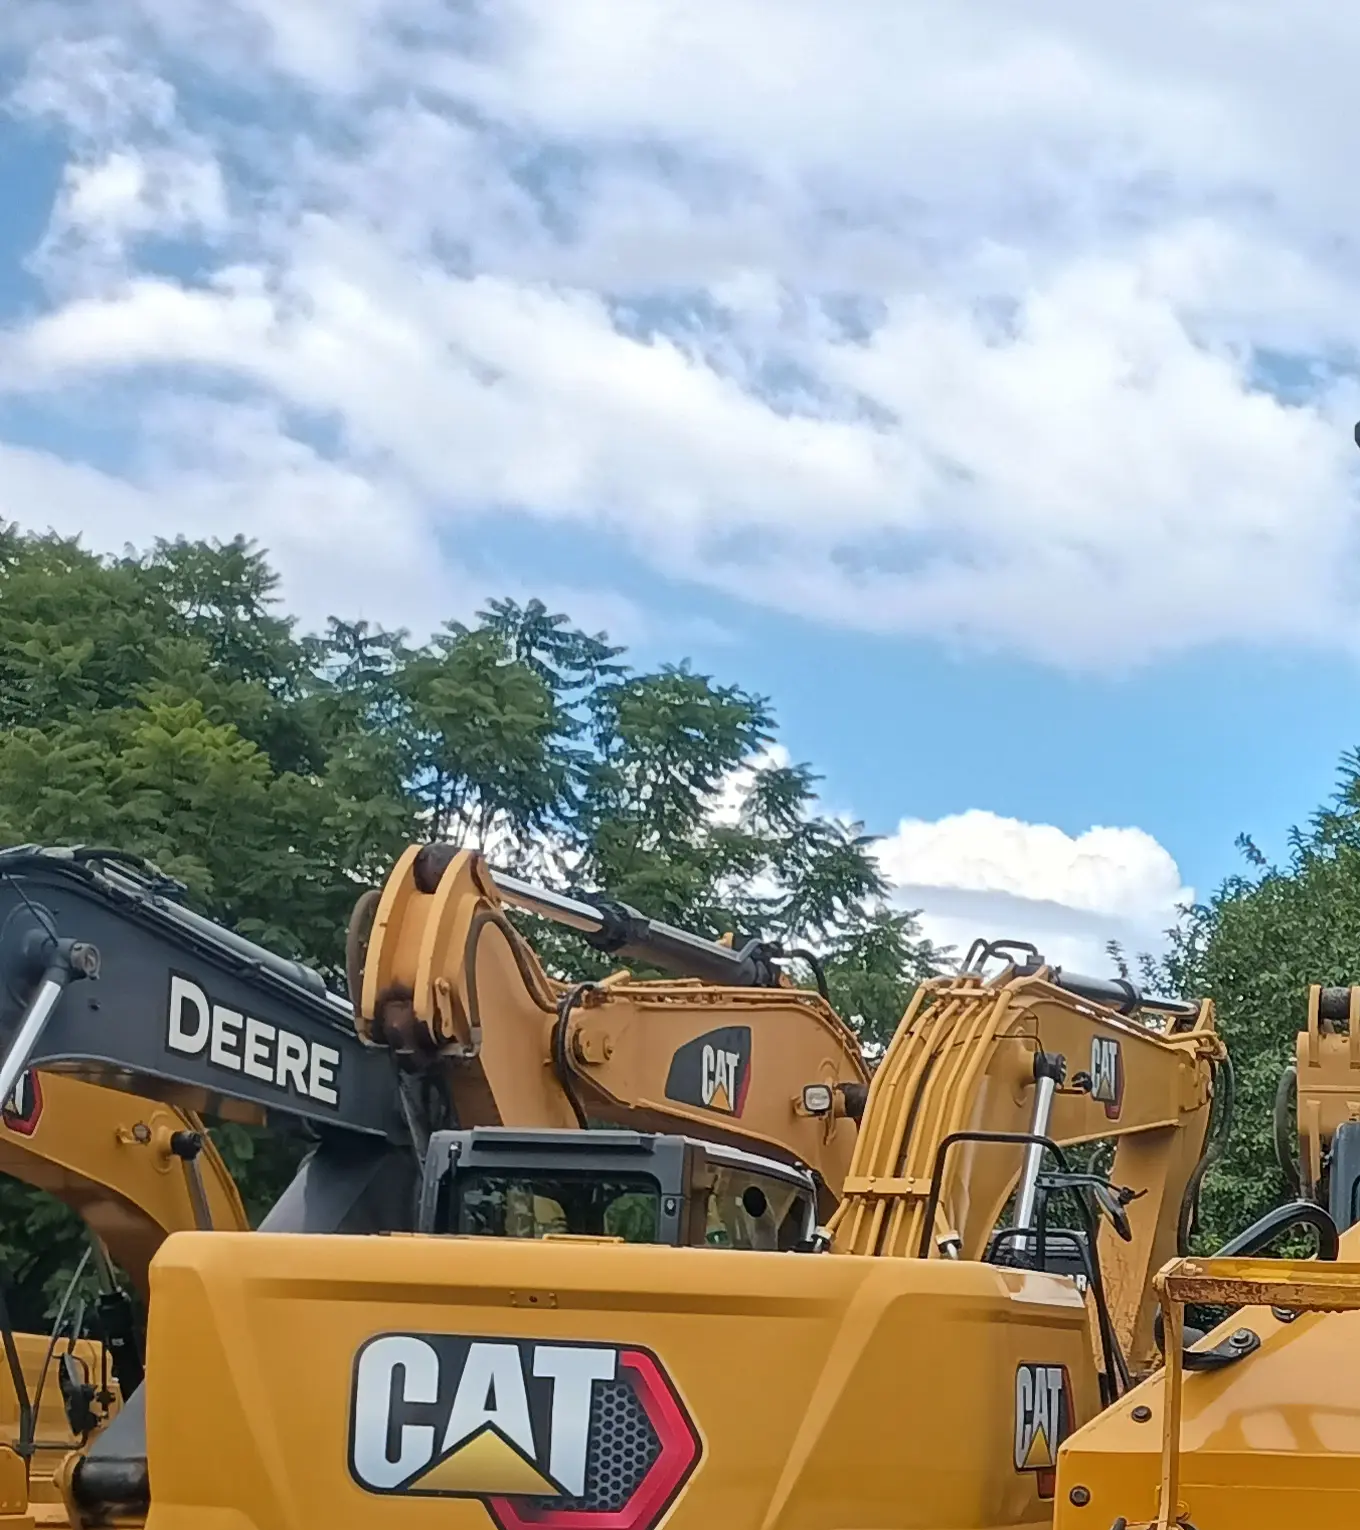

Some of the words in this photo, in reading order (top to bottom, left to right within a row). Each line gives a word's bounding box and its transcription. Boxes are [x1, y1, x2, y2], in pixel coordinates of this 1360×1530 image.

[168, 975, 340, 1105] DEERE
[701, 1044, 740, 1112] CAT
[1091, 1038, 1118, 1101] CAT
[354, 1335, 617, 1497] CAT
[1015, 1366, 1063, 1468] CAT
